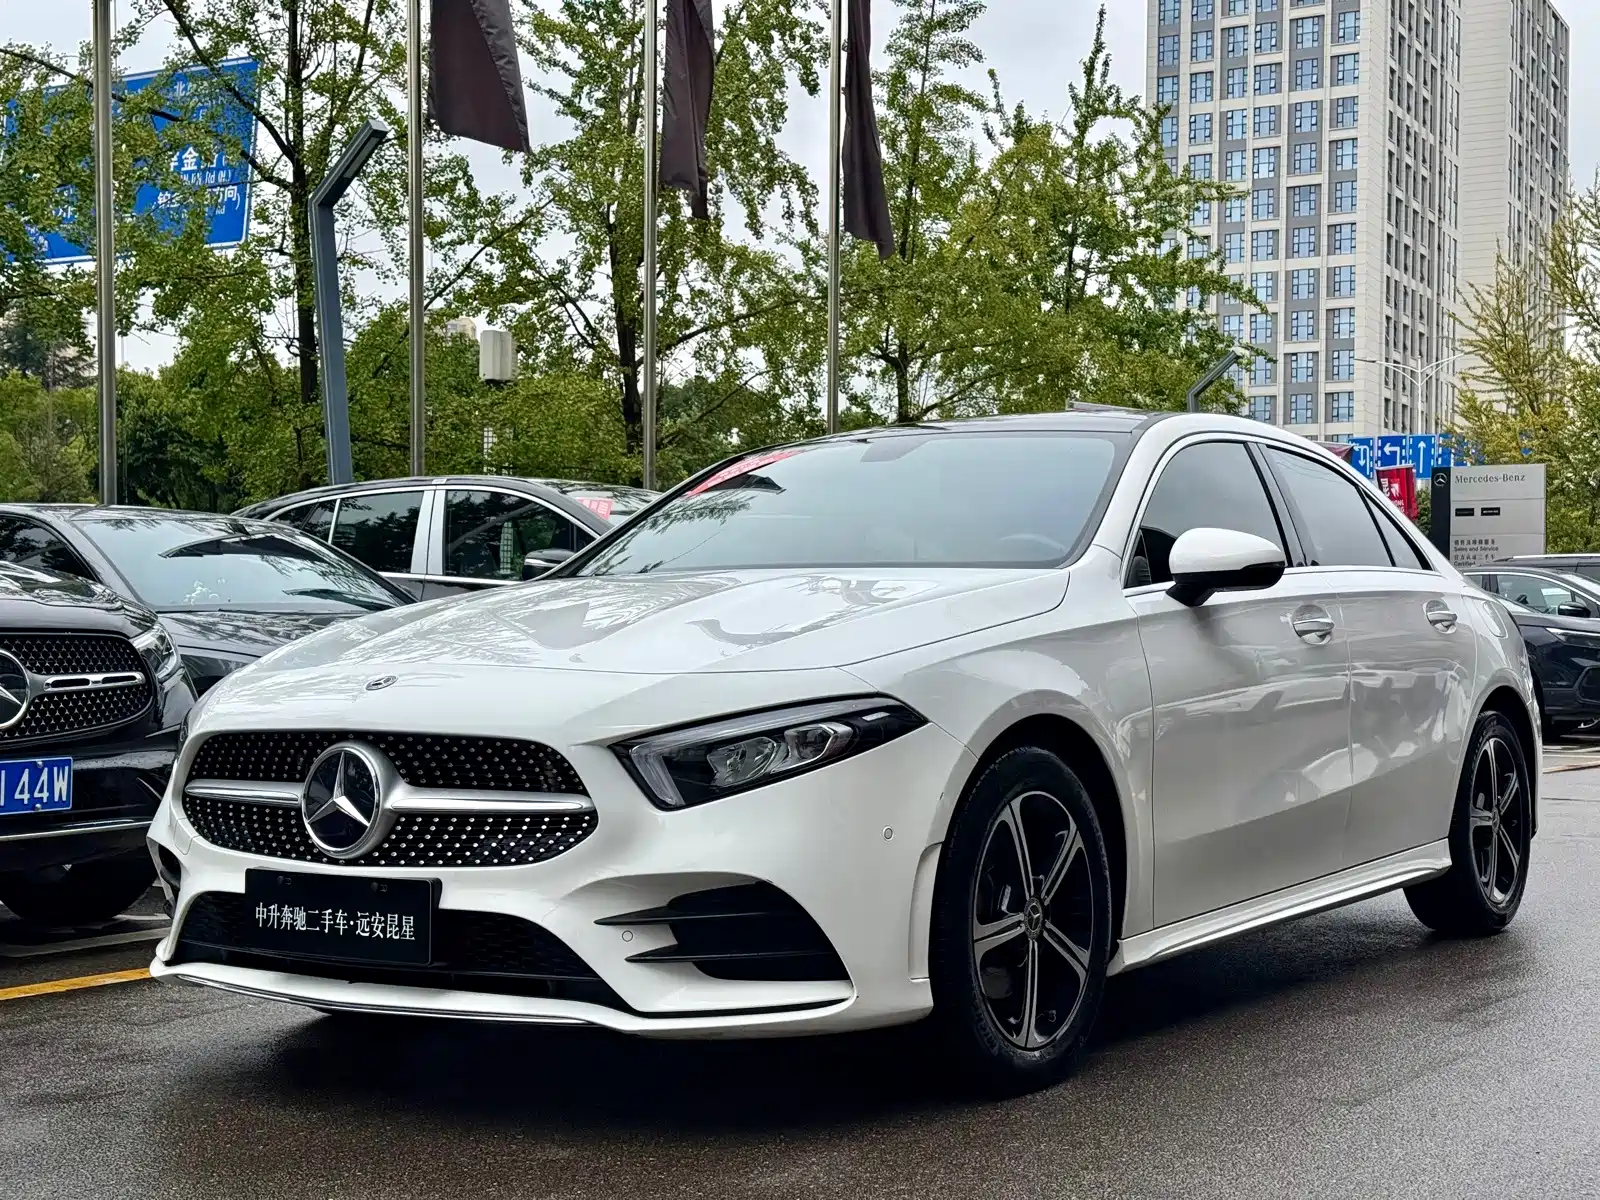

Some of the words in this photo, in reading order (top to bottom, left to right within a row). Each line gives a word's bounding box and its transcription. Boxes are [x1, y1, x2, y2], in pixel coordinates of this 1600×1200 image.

[1455, 473, 1526, 484] Mercedes-Benz
[255, 901, 416, 941] 中升奔驰二手车·远安昆星
